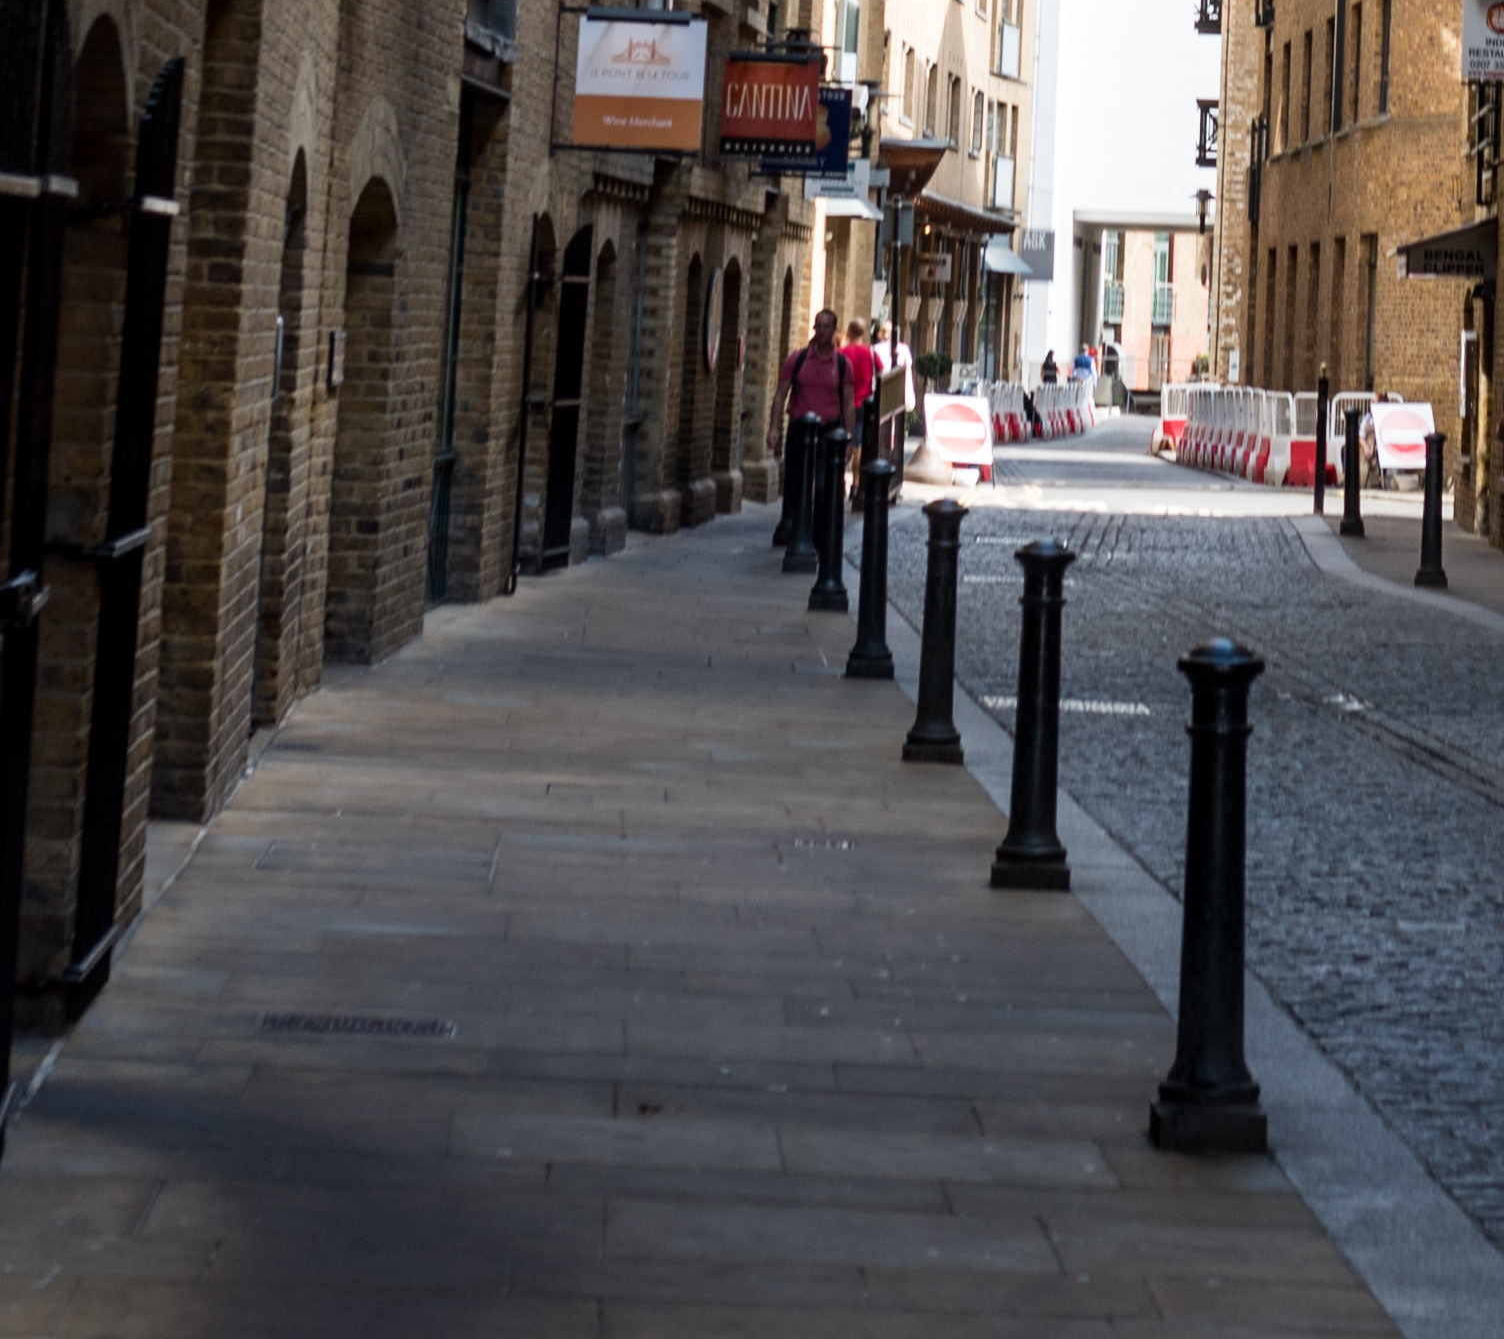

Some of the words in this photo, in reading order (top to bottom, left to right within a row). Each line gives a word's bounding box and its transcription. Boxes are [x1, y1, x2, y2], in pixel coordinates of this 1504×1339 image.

[726, 83, 812, 121] CANTINA
[1023, 231, 1046, 251] ASK
[1424, 249, 1484, 261] BENGAL
[1423, 262, 1484, 274] CLIPPER
